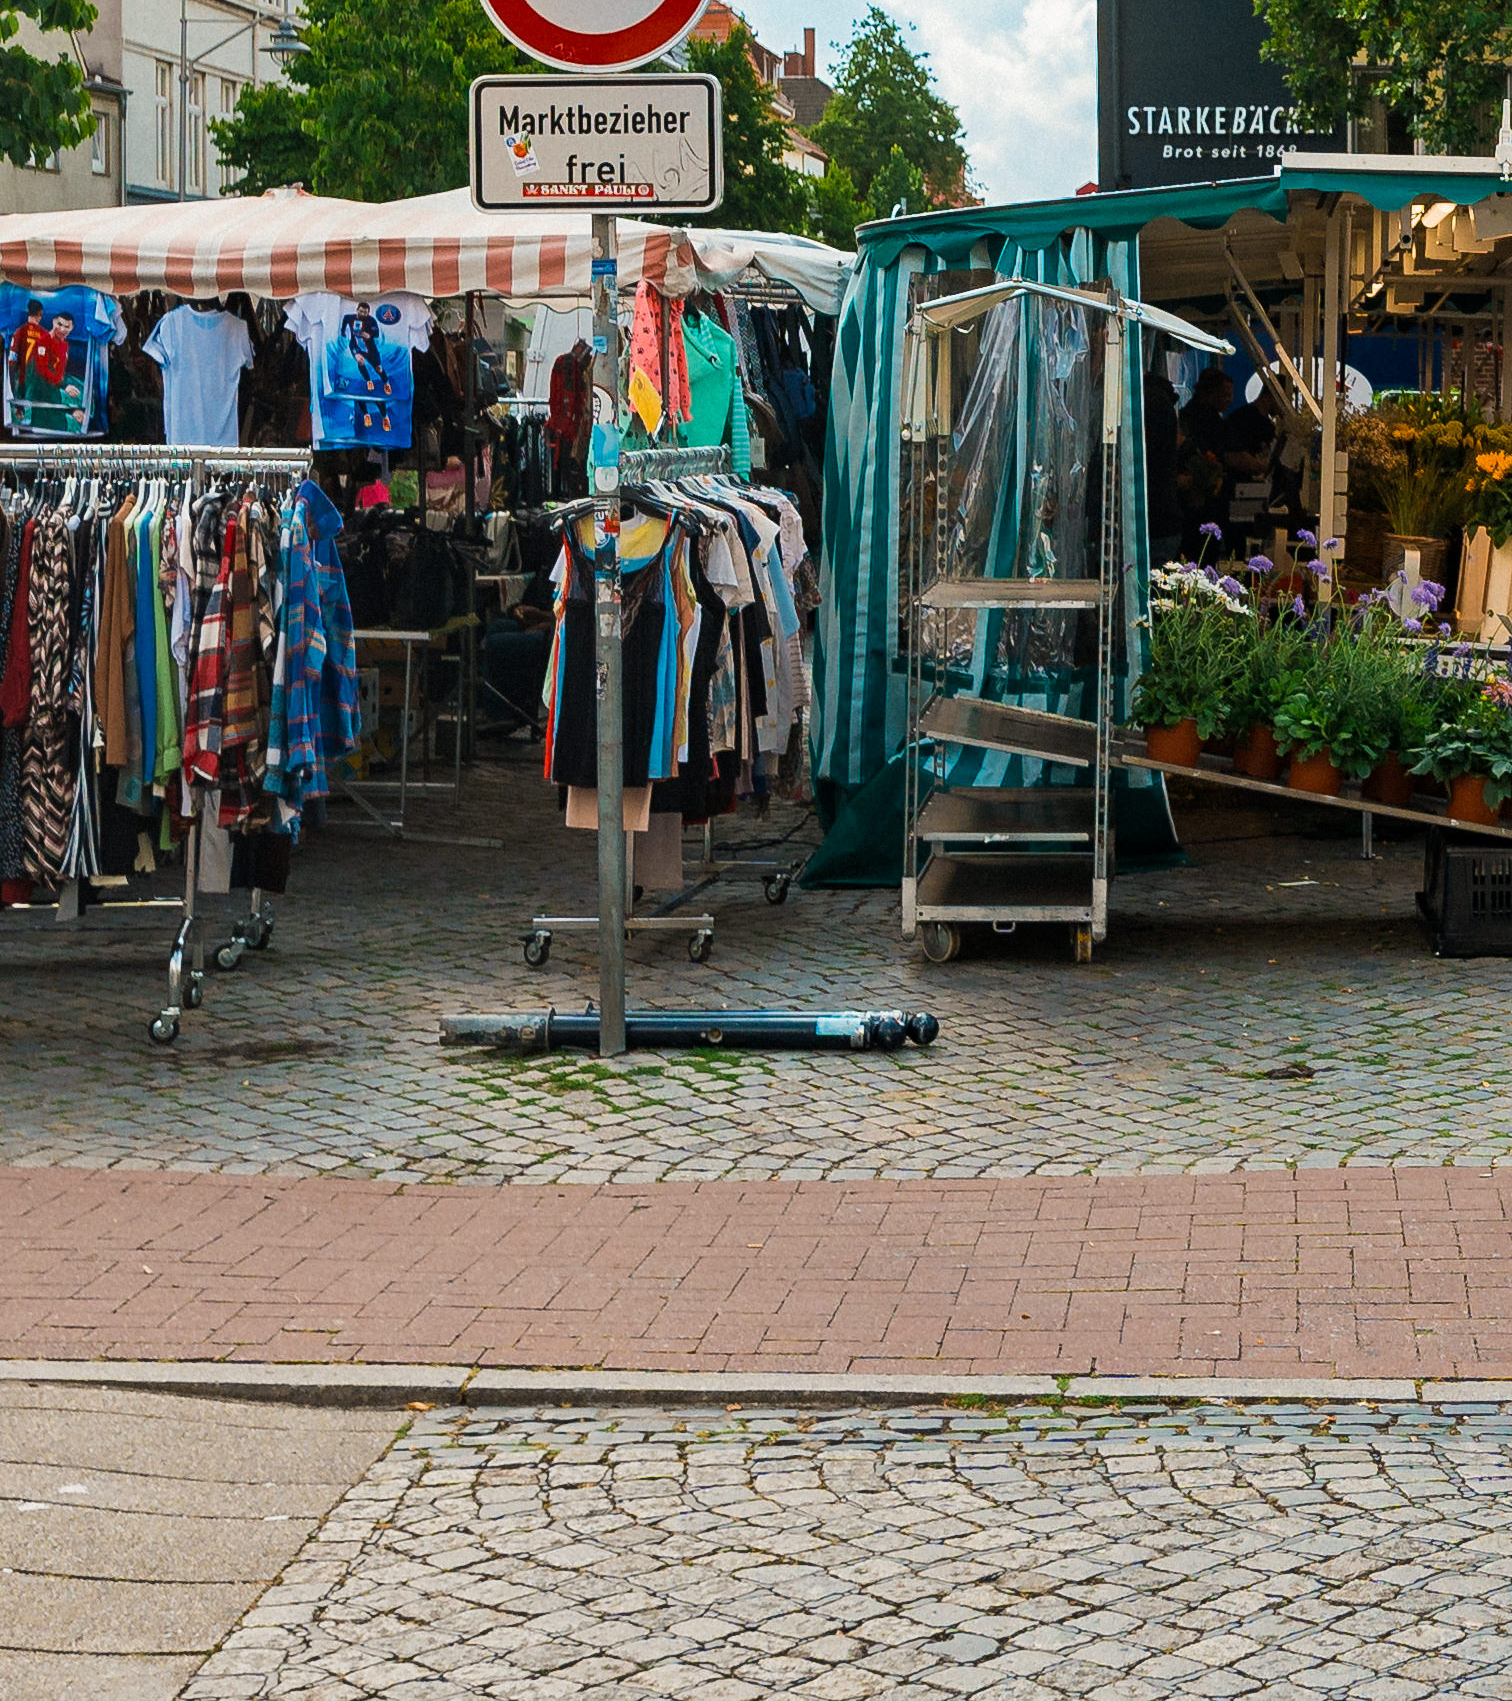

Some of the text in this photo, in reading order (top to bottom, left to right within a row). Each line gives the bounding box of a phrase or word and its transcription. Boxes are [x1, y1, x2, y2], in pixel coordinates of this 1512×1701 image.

[499, 104, 691, 135] Marktbezieher
[1127, 104, 1334, 135] STARKEBÄCK
[1162, 144, 1203, 159] Brot
[1211, 145, 1247, 159] seit
[566, 153, 625, 184] frei
[540, 183, 636, 196] SANKT PAULI
